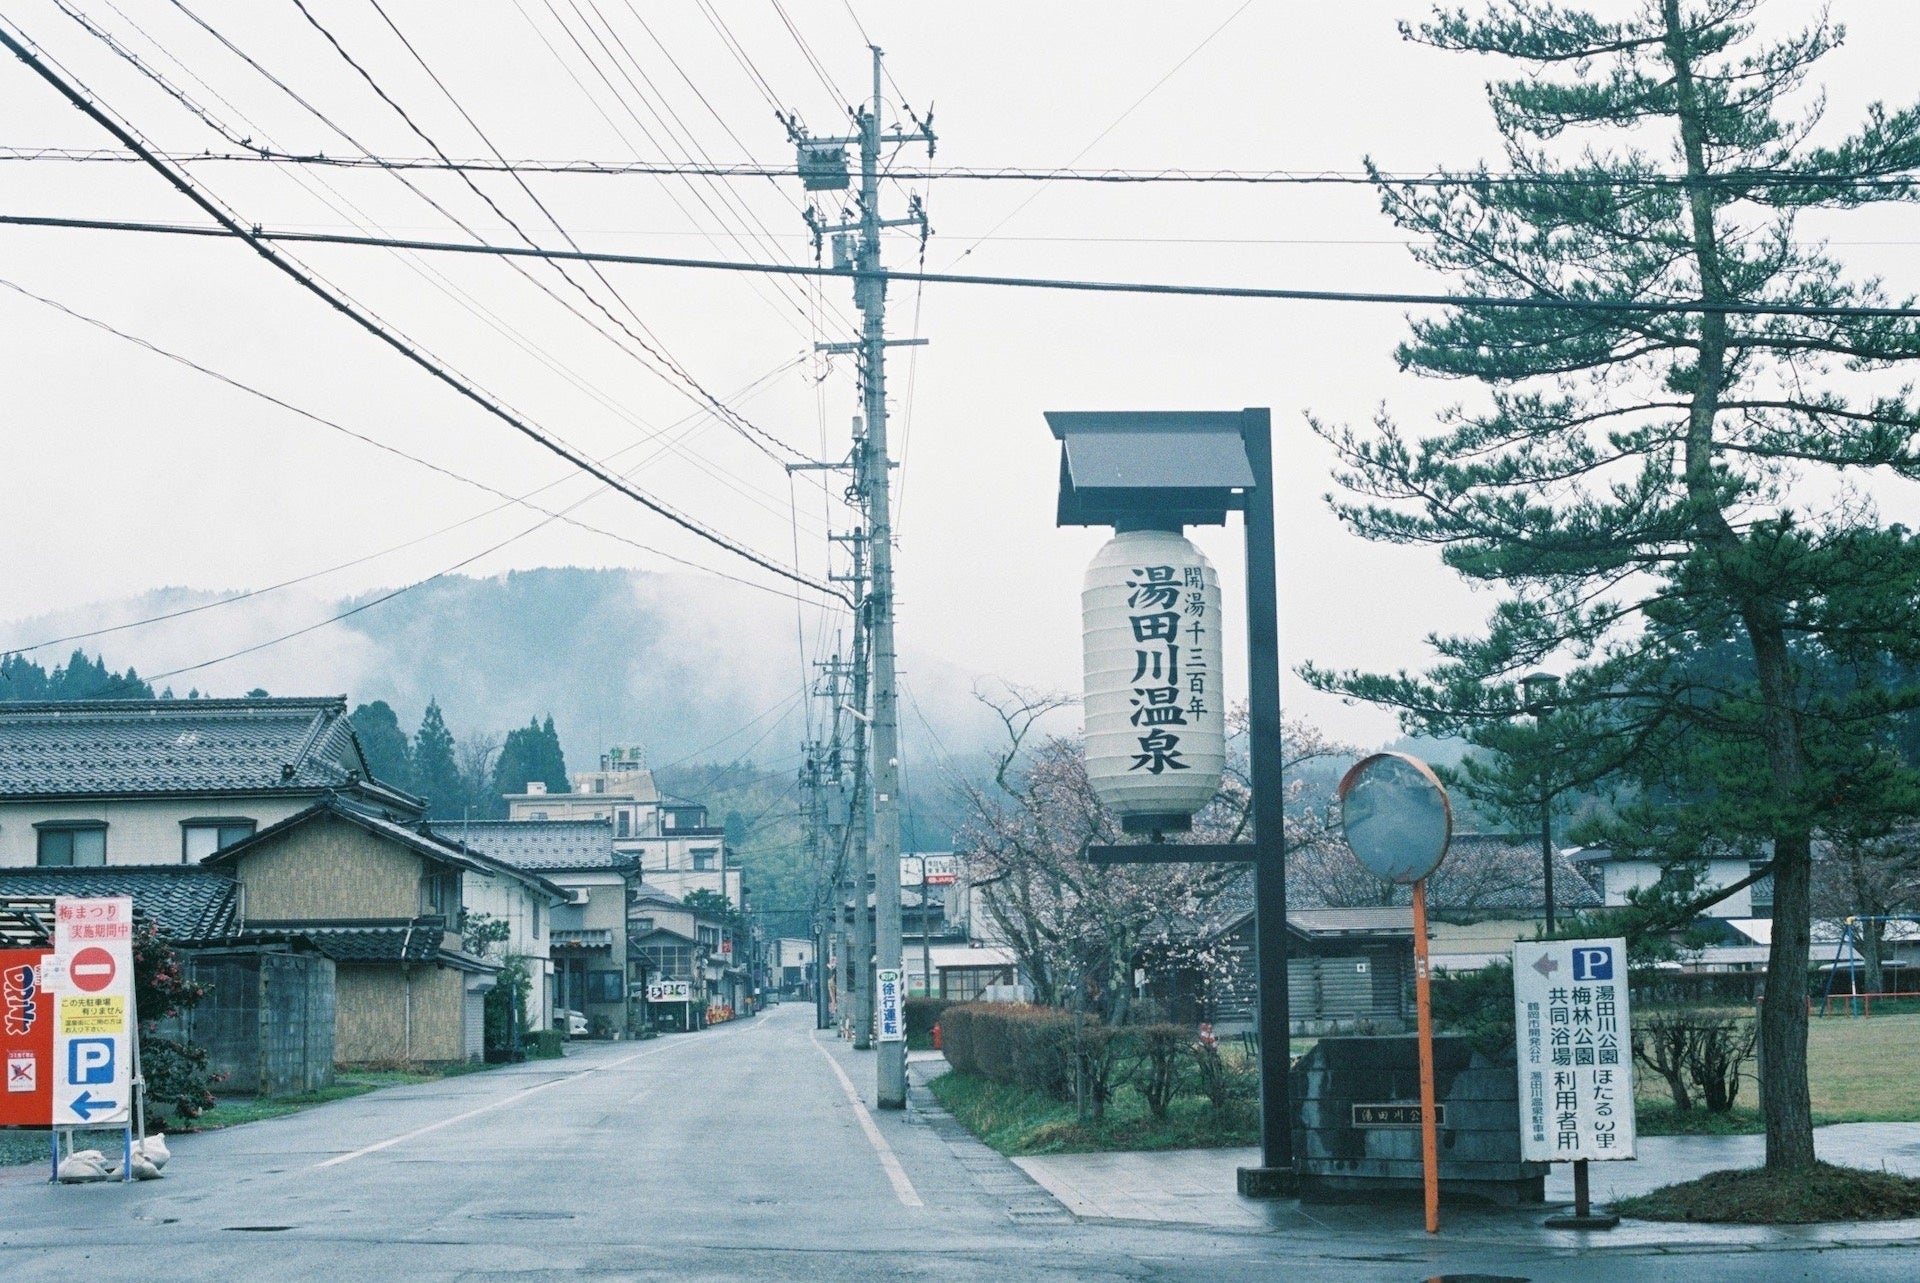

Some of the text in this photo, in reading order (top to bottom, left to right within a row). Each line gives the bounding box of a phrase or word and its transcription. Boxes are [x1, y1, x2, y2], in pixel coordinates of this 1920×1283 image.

[1183, 567, 1208, 722] 開湯千三百年
[1127, 565, 1191, 775] 湯田川温泉
[59, 905, 117, 920] 梅まつり
[72, 924, 128, 939] 実施期間中
[1580, 950, 1608, 979] P
[62, 998, 111, 1007] この先駐車場
[82, 1007, 124, 1015] 有りません
[882, 982, 897, 1034] 徐行運転
[1572, 987, 1594, 1065] 梅林公園
[1596, 986, 1619, 1065] 湯田川公園
[77, 1043, 110, 1082] P
[1549, 987, 1580, 1150] 共同浴場 利用者用
[1362, 1109, 1436, 1121] 湯田川公
